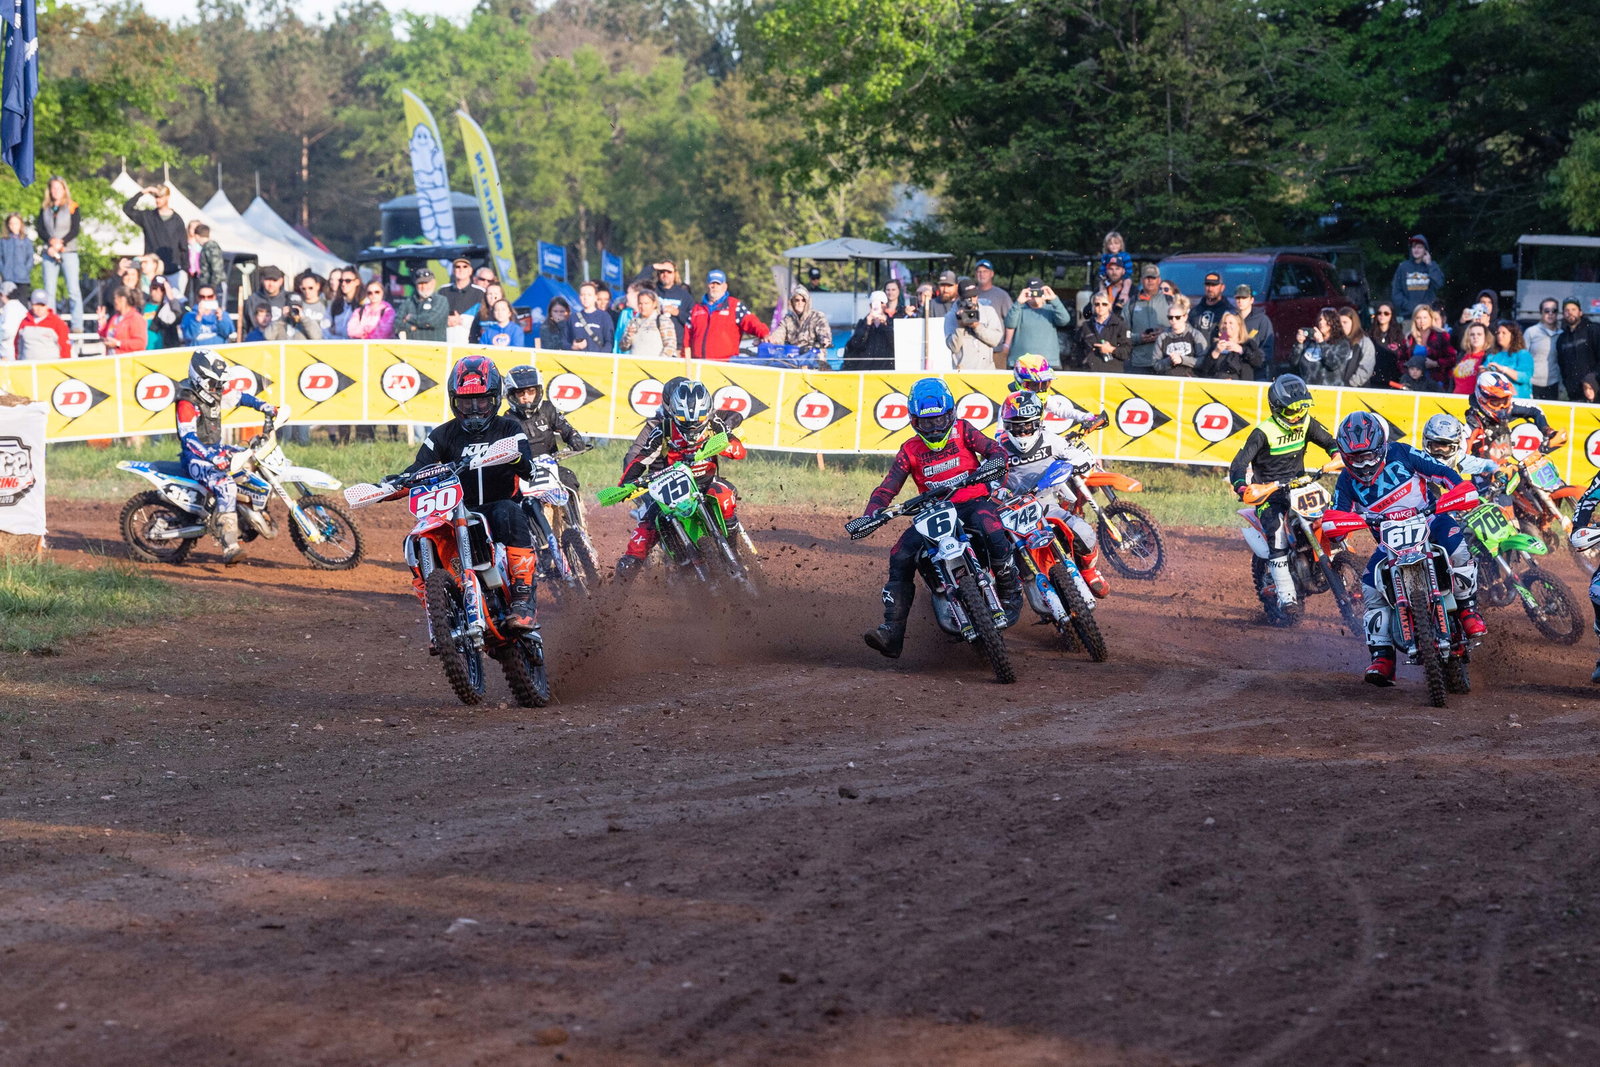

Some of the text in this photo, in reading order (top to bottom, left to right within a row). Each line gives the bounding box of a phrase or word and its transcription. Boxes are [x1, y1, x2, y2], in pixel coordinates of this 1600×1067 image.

[305, 375, 333, 389] D
[60, 391, 87, 405] D
[142, 385, 170, 400] D
[553, 385, 582, 399] D
[635, 391, 662, 405] D
[720, 397, 747, 412] D
[801, 403, 830, 418] D
[881, 404, 908, 419] D
[960, 405, 989, 419] D
[1122, 410, 1149, 424] D
[1200, 415, 1229, 429] D
[1277, 429, 1304, 445] THOR
[1513, 435, 1541, 451] D
[932, 472, 969, 490] Husqvarna
[1351, 460, 1411, 506] FXR
[658, 474, 690, 505] 15
[417, 487, 457, 520] 50
[928, 511, 950, 538] 6
[1010, 504, 1038, 531] 742
[1471, 506, 1508, 543] 708
[1387, 523, 1426, 549] 617
[1398, 606, 1412, 641] MAXXIS
[1437, 604, 1448, 633] MAXXIS
